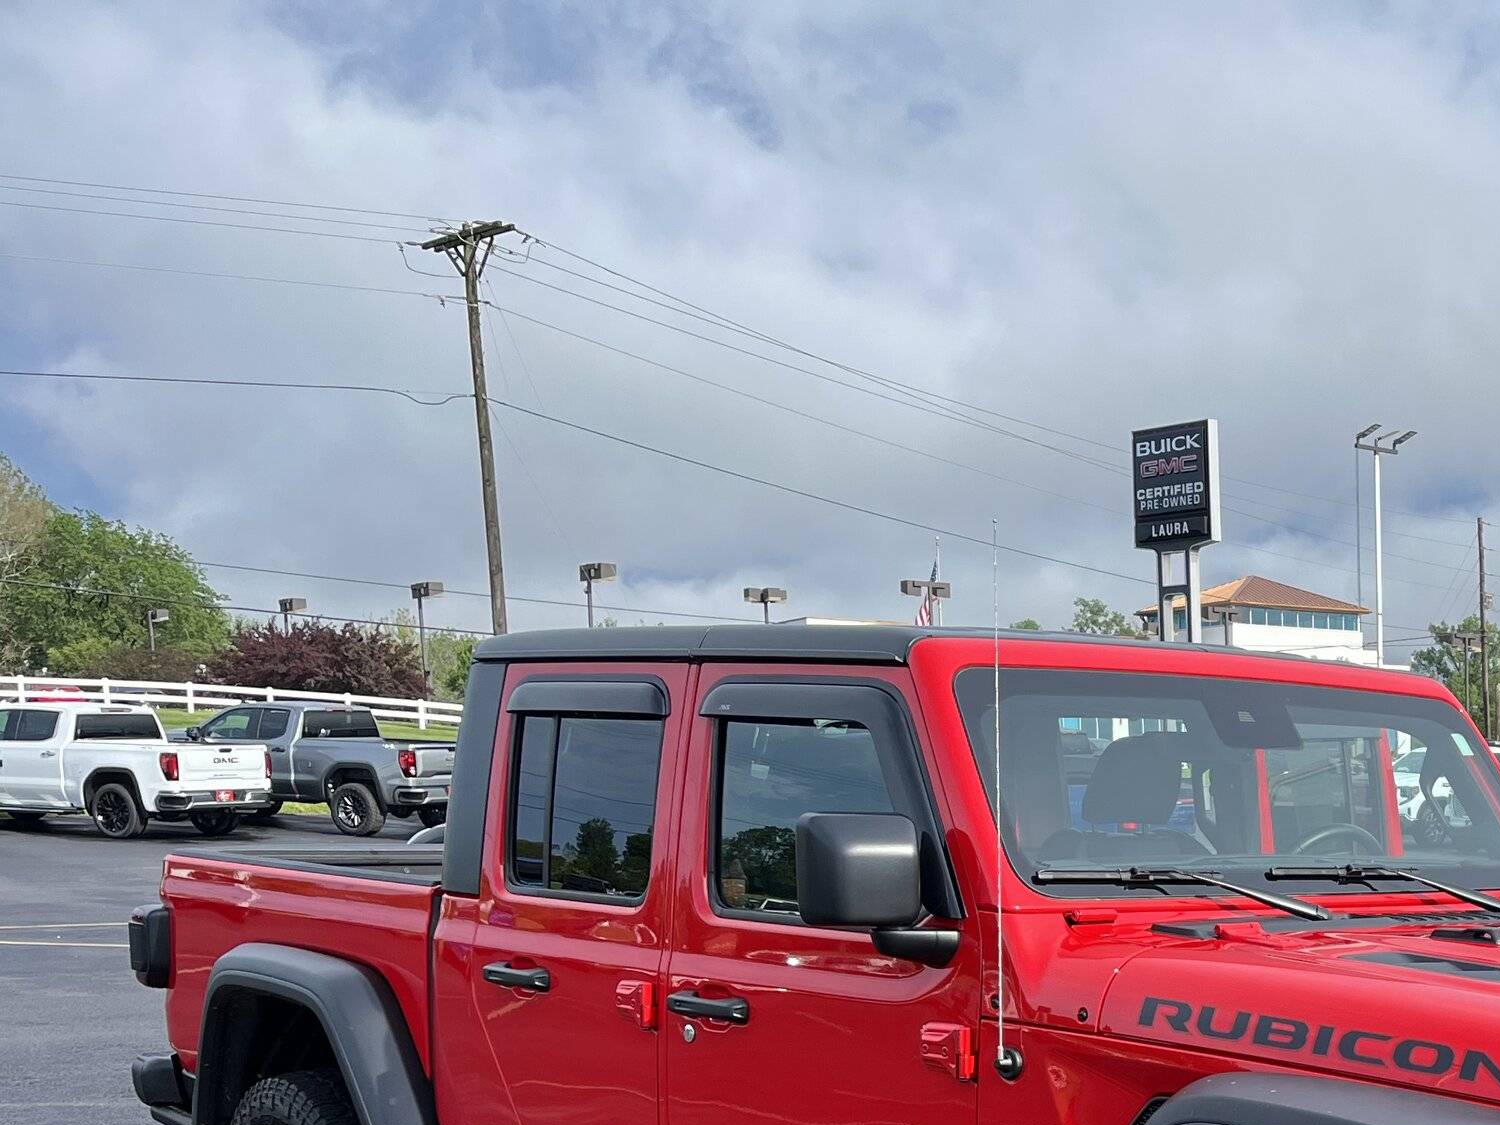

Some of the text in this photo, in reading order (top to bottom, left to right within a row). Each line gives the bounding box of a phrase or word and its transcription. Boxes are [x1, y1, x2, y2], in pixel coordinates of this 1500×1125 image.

[1136, 434, 1200, 457] BUICK
[1140, 455, 1198, 478] GMC
[1136, 481, 1204, 500] CERTIFIED
[1140, 494, 1201, 511] PRE-OWNED
[1151, 521, 1190, 538] LAURA
